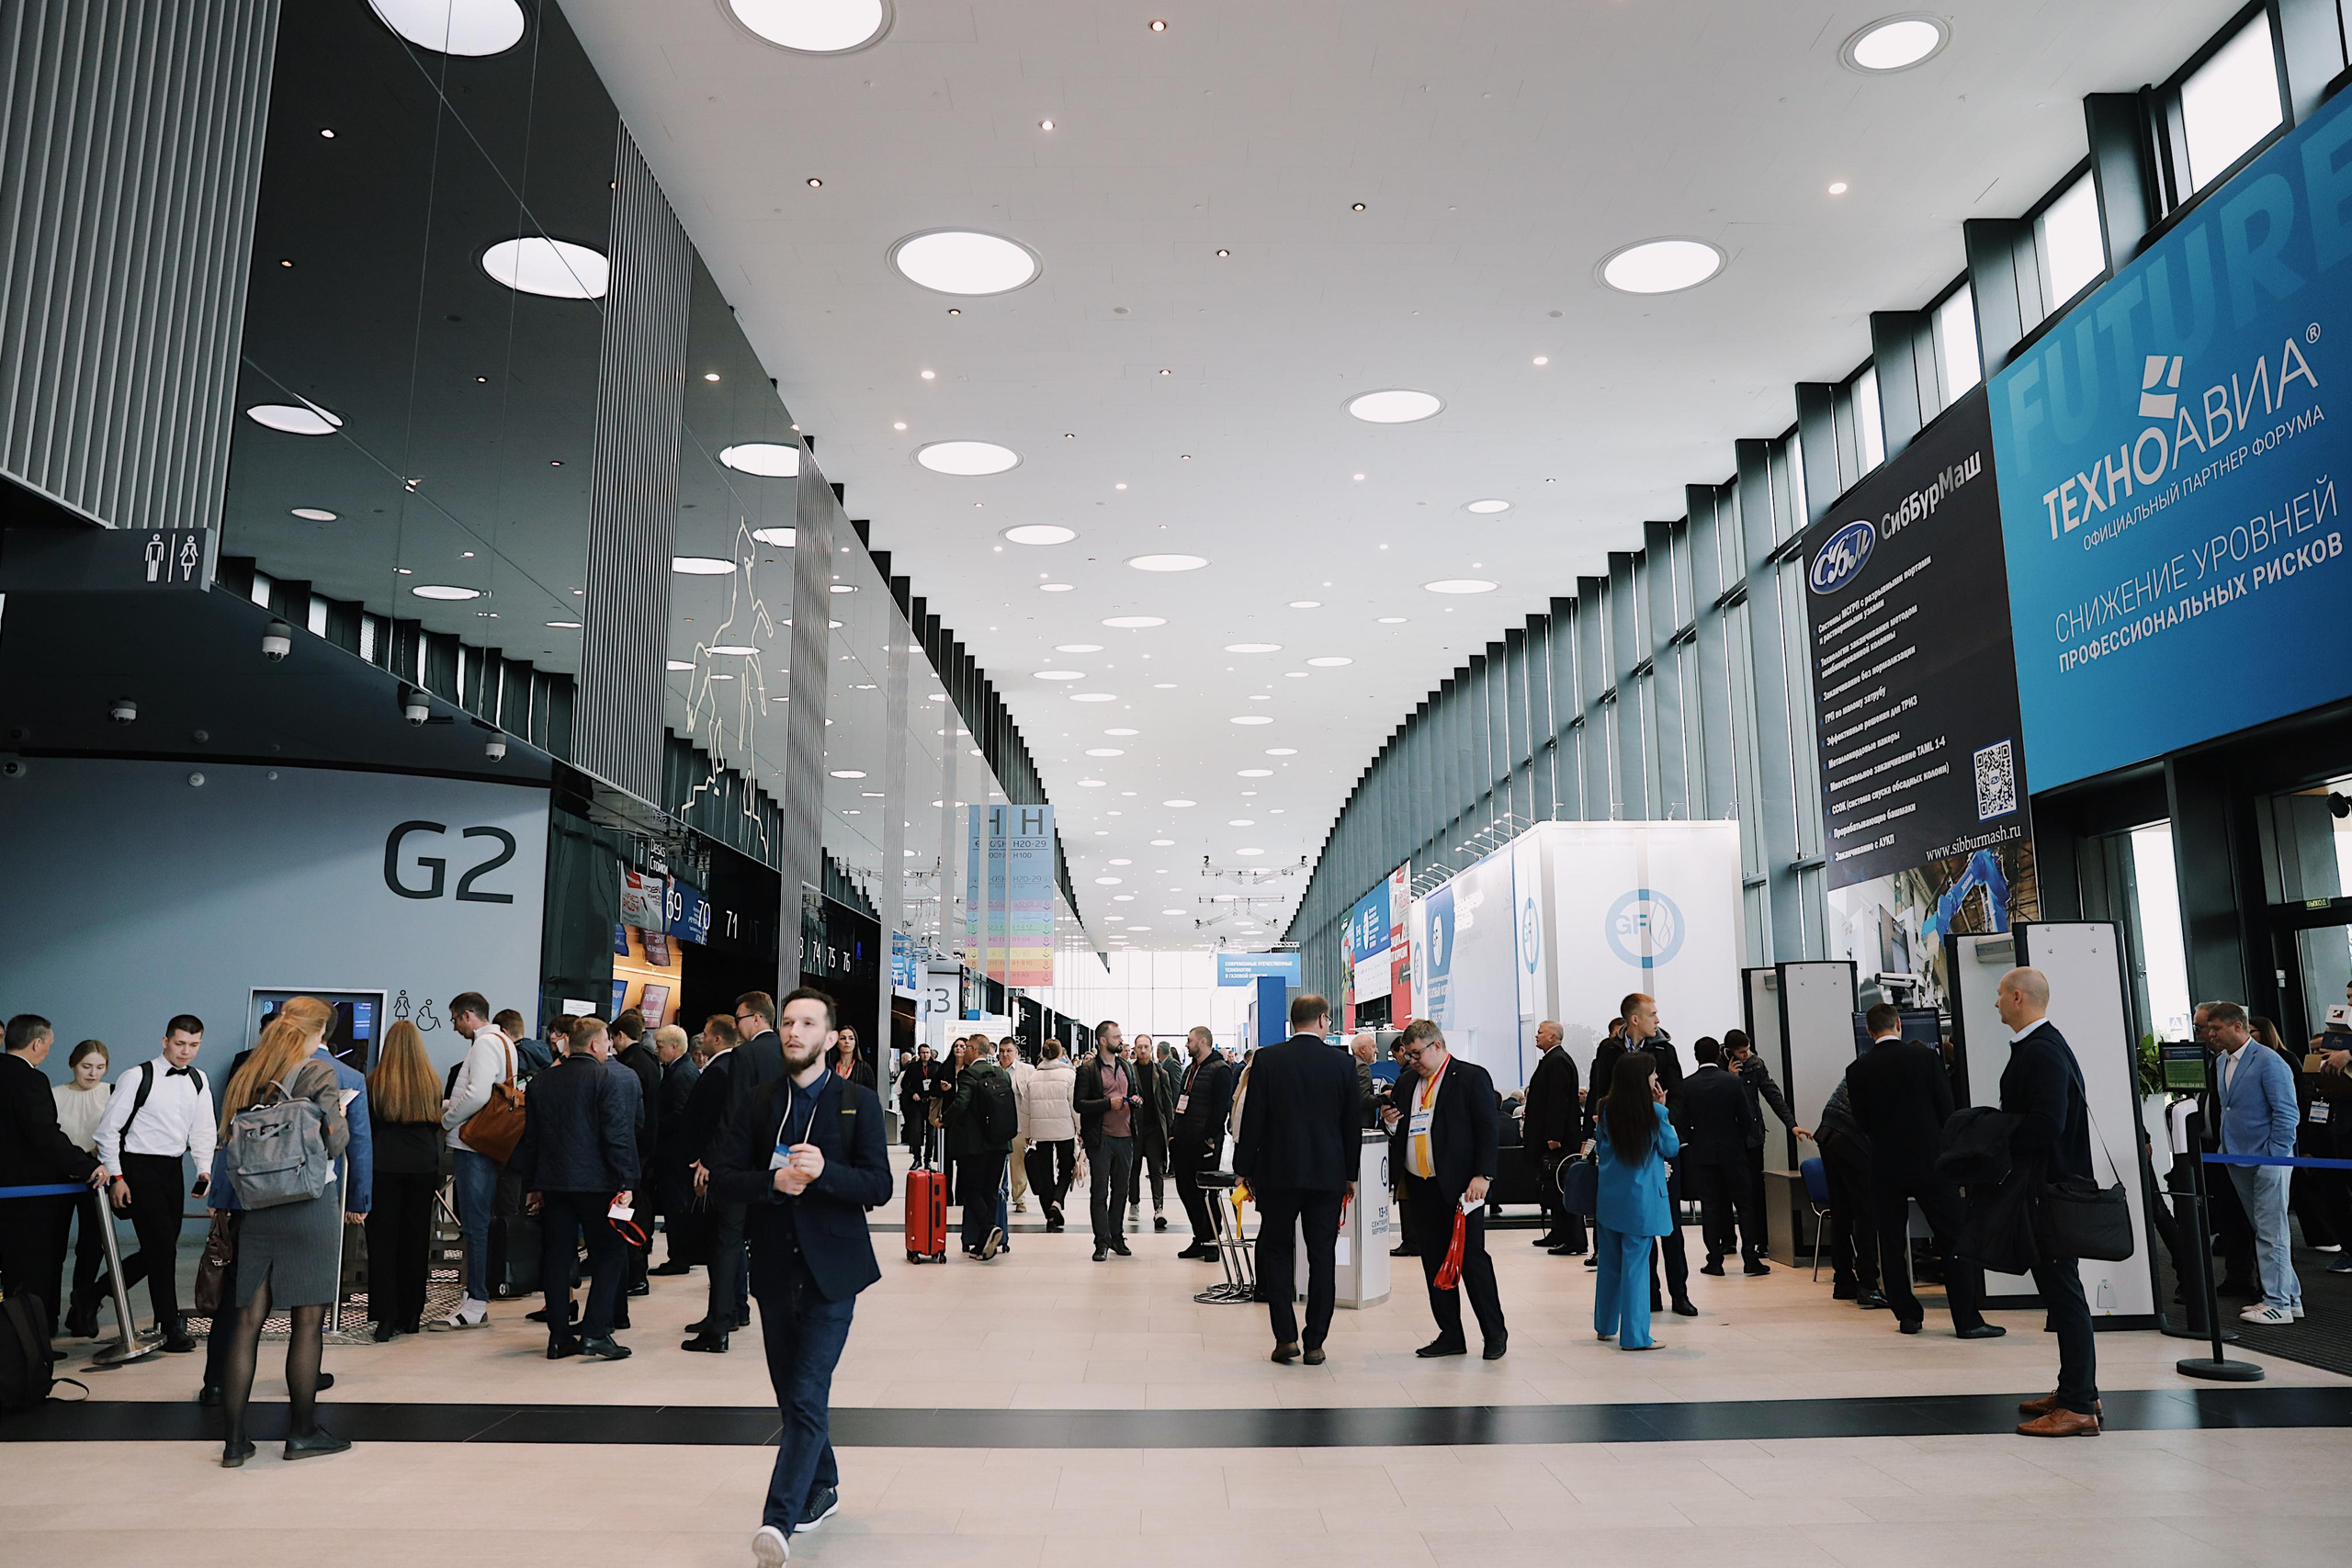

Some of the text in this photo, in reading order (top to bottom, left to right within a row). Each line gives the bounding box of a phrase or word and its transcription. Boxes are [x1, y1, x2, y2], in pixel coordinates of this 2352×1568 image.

[1881, 450, 1982, 540] СибБурМаш
[2083, 404, 2325, 551] ОФИЦИАЛЬНЫЙ ПАРТНЕР ФОРУМА
[2055, 474, 2338, 643] СНИЖЕНИЕ УРОВНЕЙ
[1818, 556, 1931, 634] Системы МСГРП с разрывными портами
[2059, 532, 2344, 673] ПРОФЕССИОНАЛЬНЫХ РИСКОВ
[1820, 604, 1917, 668] Технологии заканчивания методом
[1823, 612, 1863, 645] растворимыми
[1863, 599, 1884, 620] узлами
[1821, 630, 1896, 680] комбинированной колонны
[1823, 645, 1916, 701] Заканчивание без нормализации
[1825, 685, 1886, 724] ГРП по малому затрубу
[1826, 695, 1917, 746] Эффективные решения для ТРИЗ
[1877, 731, 1901, 749] пакеры
[1829, 767, 1873, 793] Многоствольное
[1873, 750, 1917, 774] заканчивание
[1934, 736, 1946, 749] 1-4
[1831, 761, 1950, 815] ССОК (система спуска обсадных колонн)
[1022, 809, 1043, 835] H
[1833, 802, 1917, 839] Прорабатывающие башмаки
[383, 820, 516, 905] G2
[650, 839, 666, 858] Desks
[1835, 842, 1874, 862] Заканчивание
[1879, 833, 1895, 848] АУКП
[1926, 825, 2021, 862] www.sibburmash.ru
[666, 890, 683, 921] 69
[697, 899, 711, 931] 70
[726, 910, 738, 939] 71
[1615, 914, 1647, 935] GF
[2306, 899, 2327, 908] ВЫХОД
[828, 946, 836, 968] 75
[842, 951, 851, 972] 76
